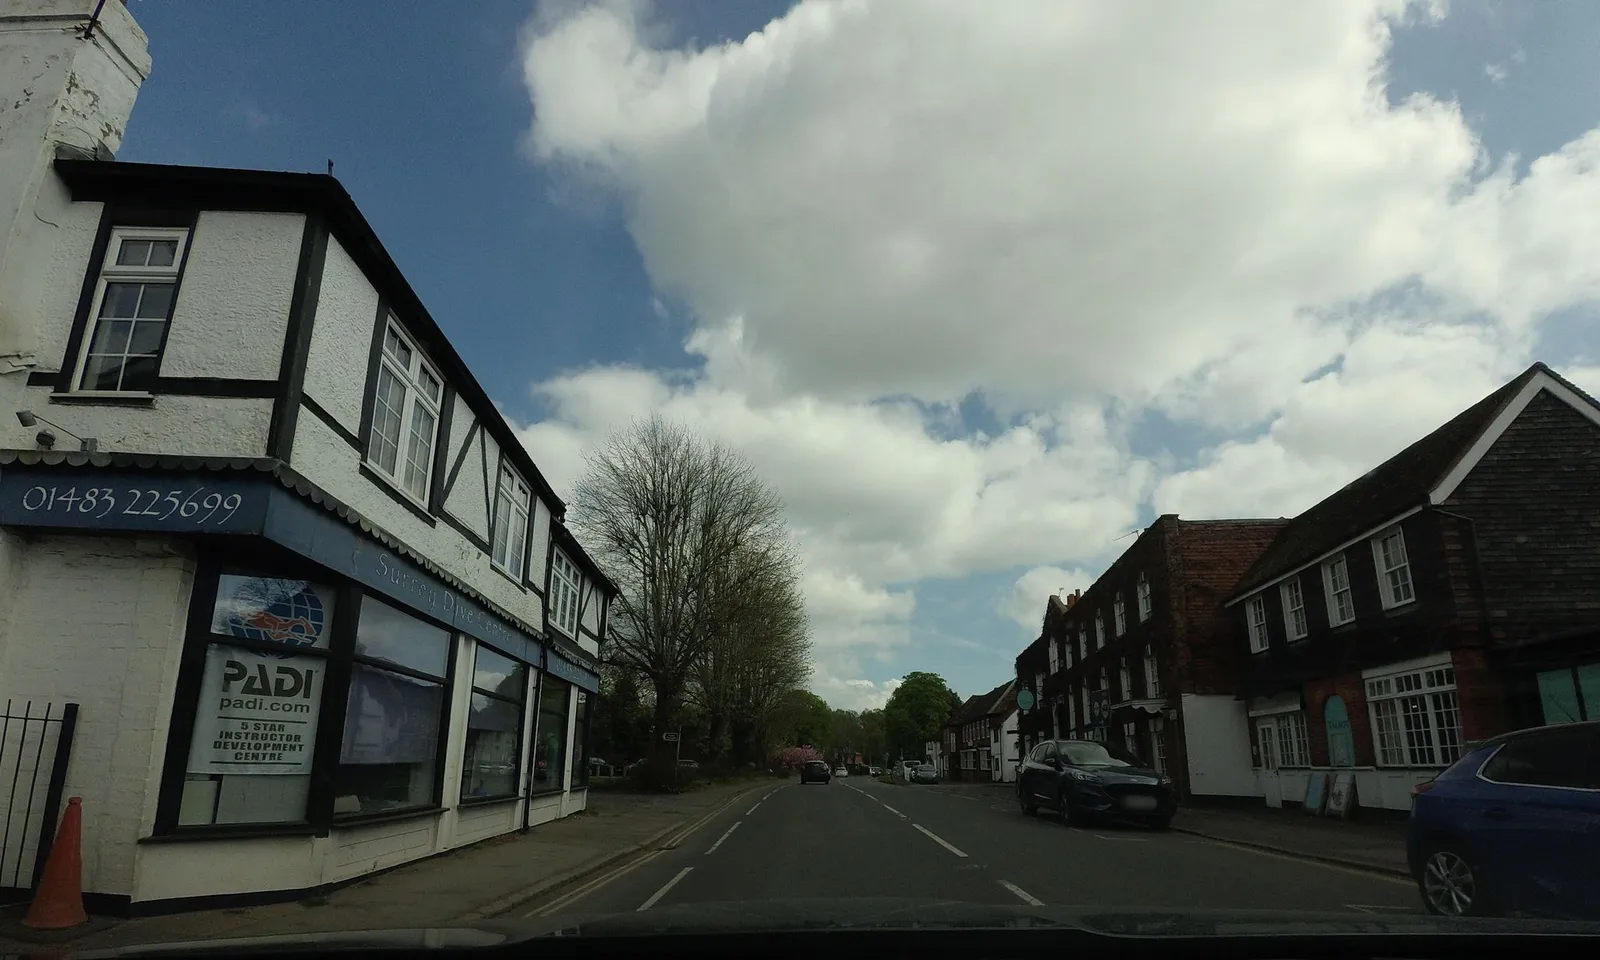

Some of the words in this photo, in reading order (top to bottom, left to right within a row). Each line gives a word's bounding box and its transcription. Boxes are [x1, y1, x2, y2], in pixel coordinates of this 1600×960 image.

[22, 486, 116, 519] 01483
[122, 486, 242, 524] 225699
[376, 553, 436, 612] Surrey
[443, 590, 473, 623] Dive
[477, 611, 512, 642] Centre
[222, 660, 313, 698] PADI
[219, 697, 310, 713] padi.com
[241, 721, 249, 731] 5
[253, 722, 285, 732] STAR
[219, 730, 302, 743] INSTRUCTOR
[213, 740, 305, 753] DEVELOPMENT
[234, 752, 283, 761] CENTRE
